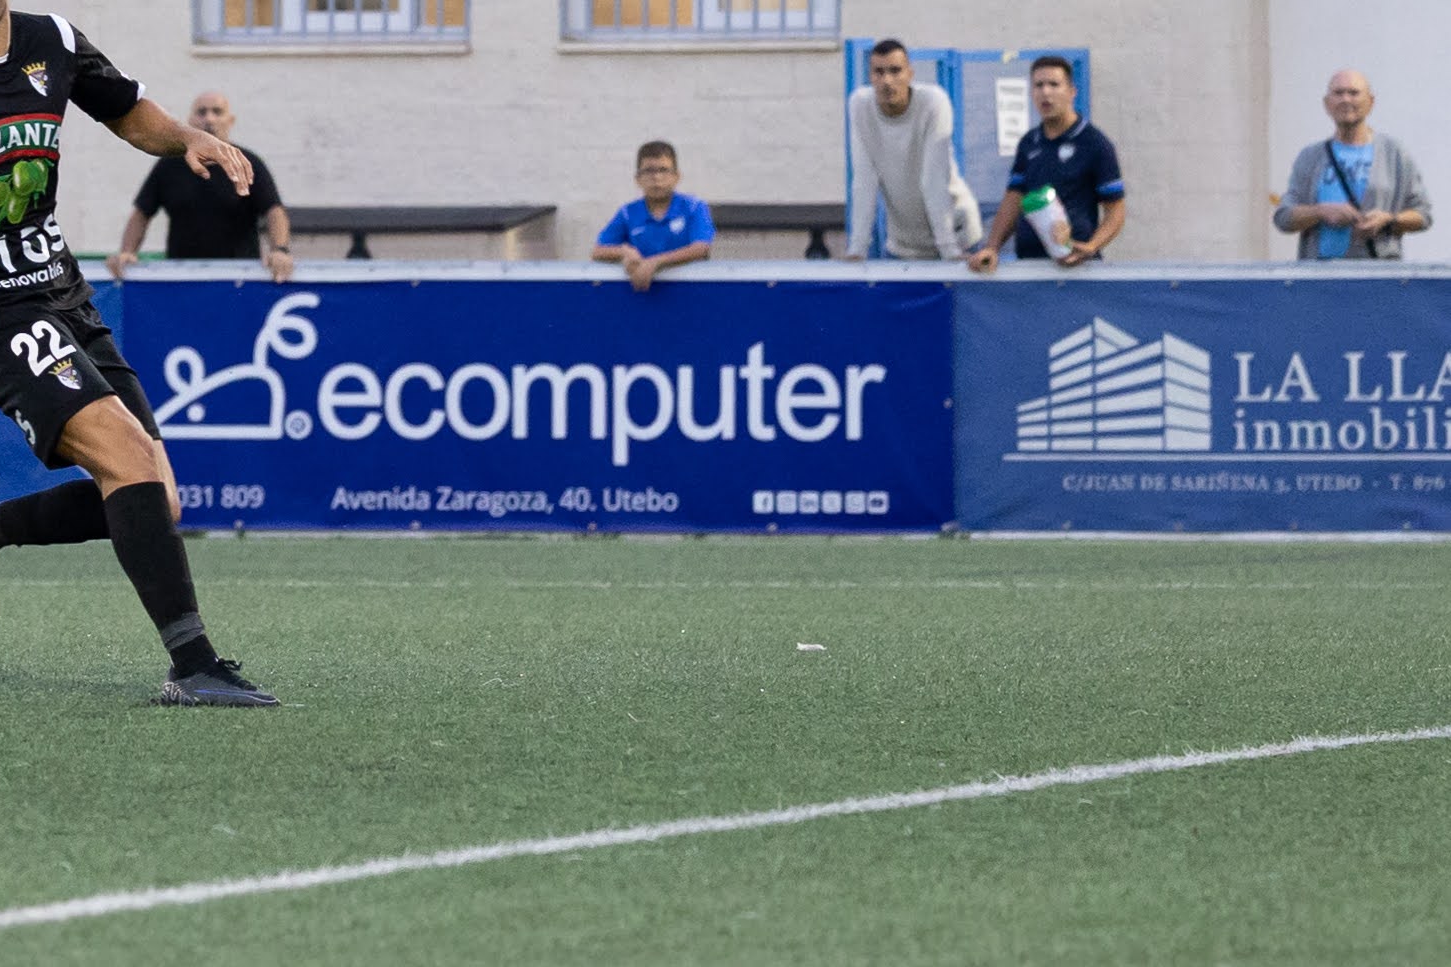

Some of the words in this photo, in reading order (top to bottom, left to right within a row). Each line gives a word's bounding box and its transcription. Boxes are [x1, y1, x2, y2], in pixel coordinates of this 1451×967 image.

[10, 320, 77, 377] 22
[1233, 351, 1320, 403] LA
[317, 342, 886, 466] ecomputer
[220, 485, 265, 509] 809
[331, 486, 431, 511] Avenida
[435, 486, 554, 518] Zaragoza,
[602, 487, 679, 513] Utebo
[1139, 473, 1166, 491] DE
